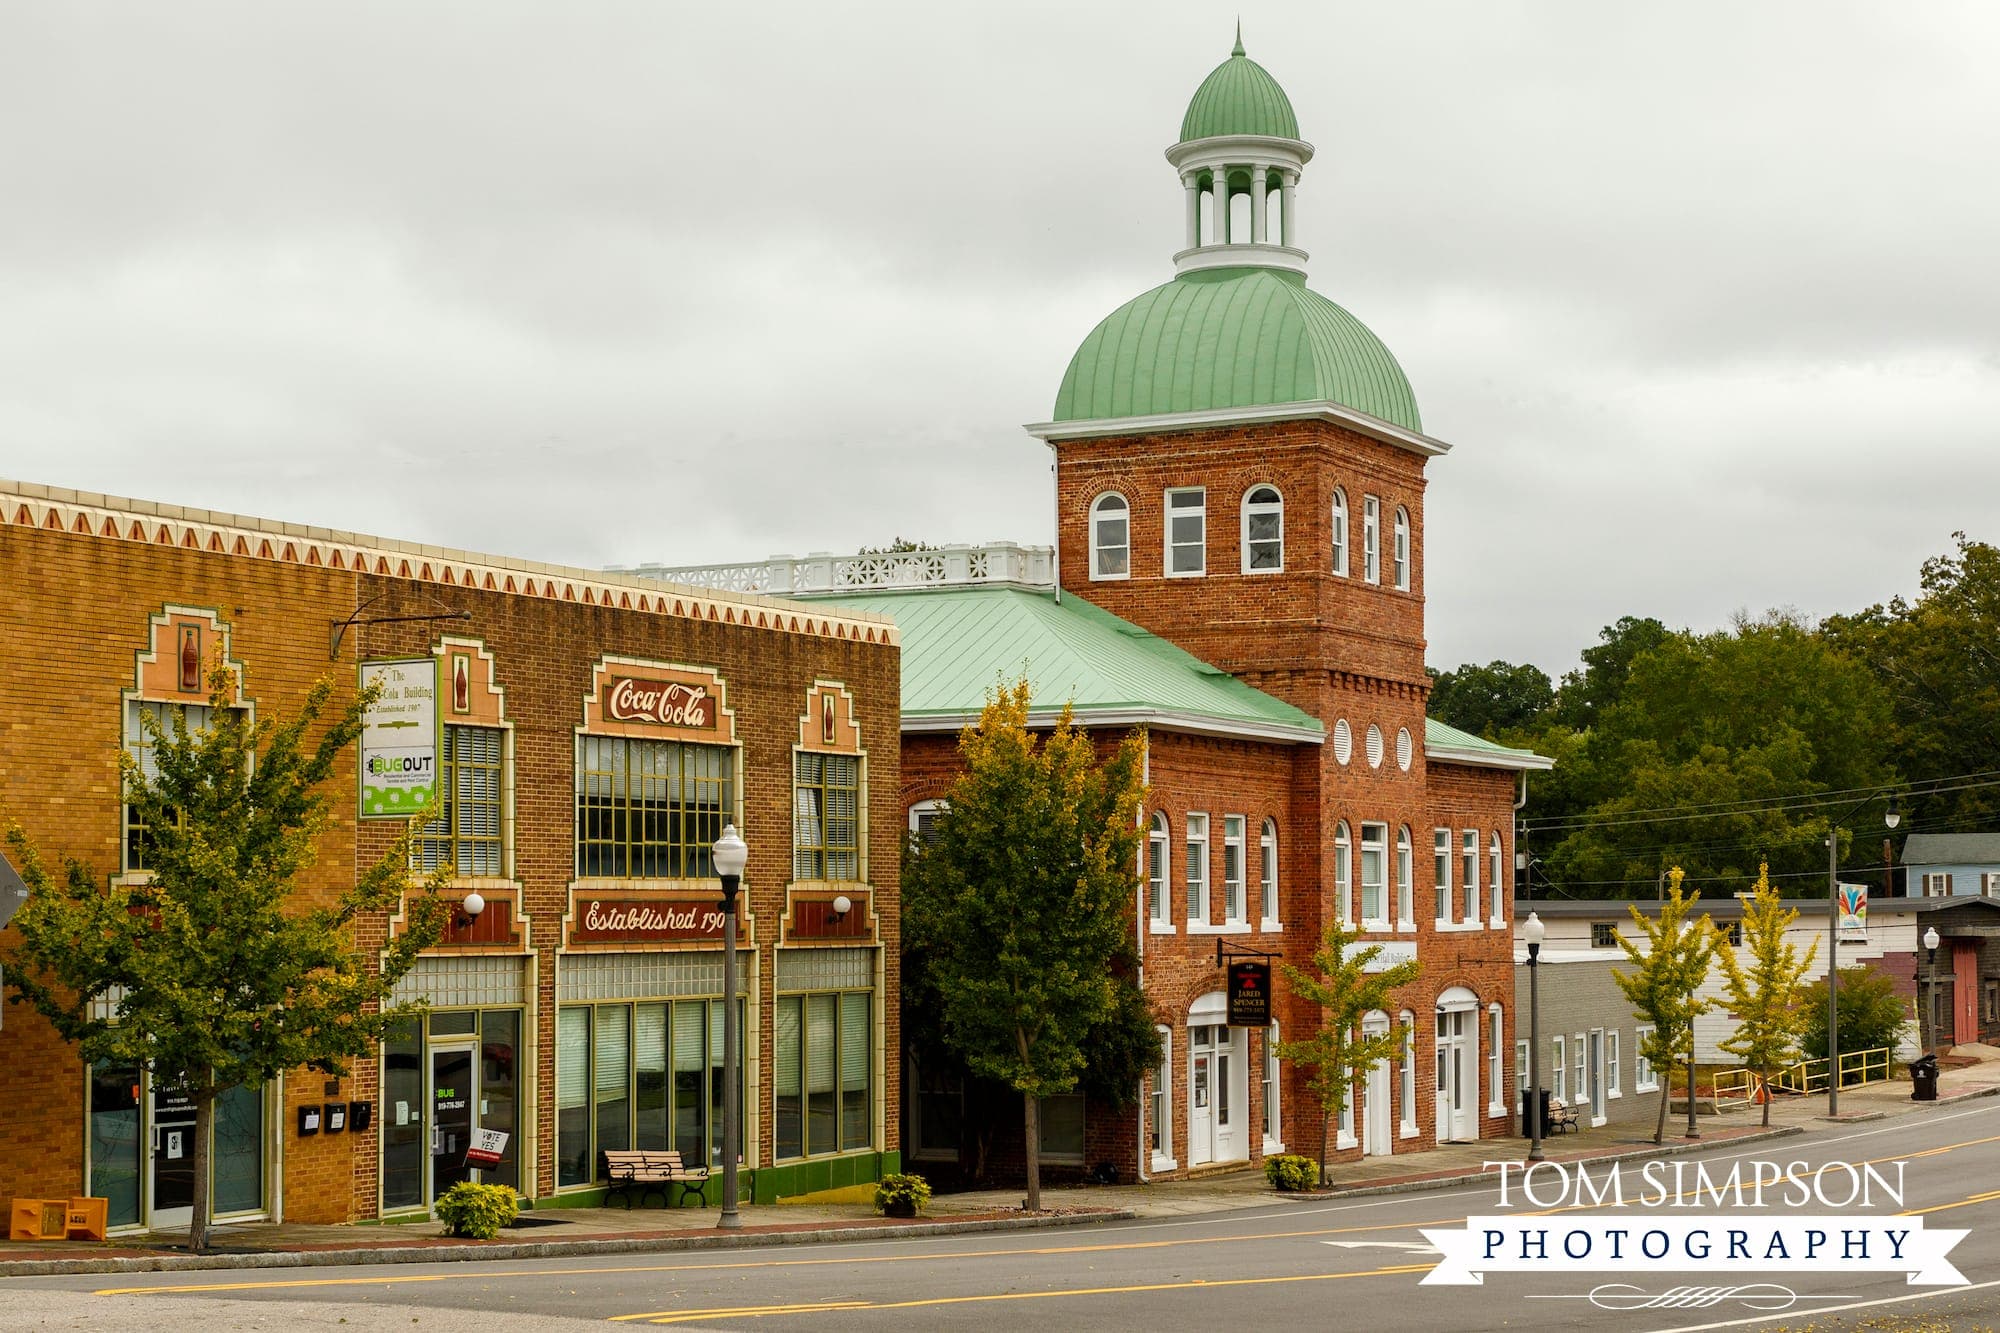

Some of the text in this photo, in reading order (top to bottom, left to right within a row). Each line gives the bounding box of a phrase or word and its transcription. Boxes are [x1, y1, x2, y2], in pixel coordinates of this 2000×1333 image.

[392, 669, 406, 681] The
[404, 685, 433, 701] Building
[610, 678, 706, 727] Coca-Cola
[585, 900, 726, 934] Established 190
[1238, 989, 1261, 998] JARED
[1233, 999, 1265, 1007] SPENCER
[437, 1087, 455, 1098] BUG
[482, 1130, 502, 1143] VOTE
[481, 1140, 495, 1151] YES
